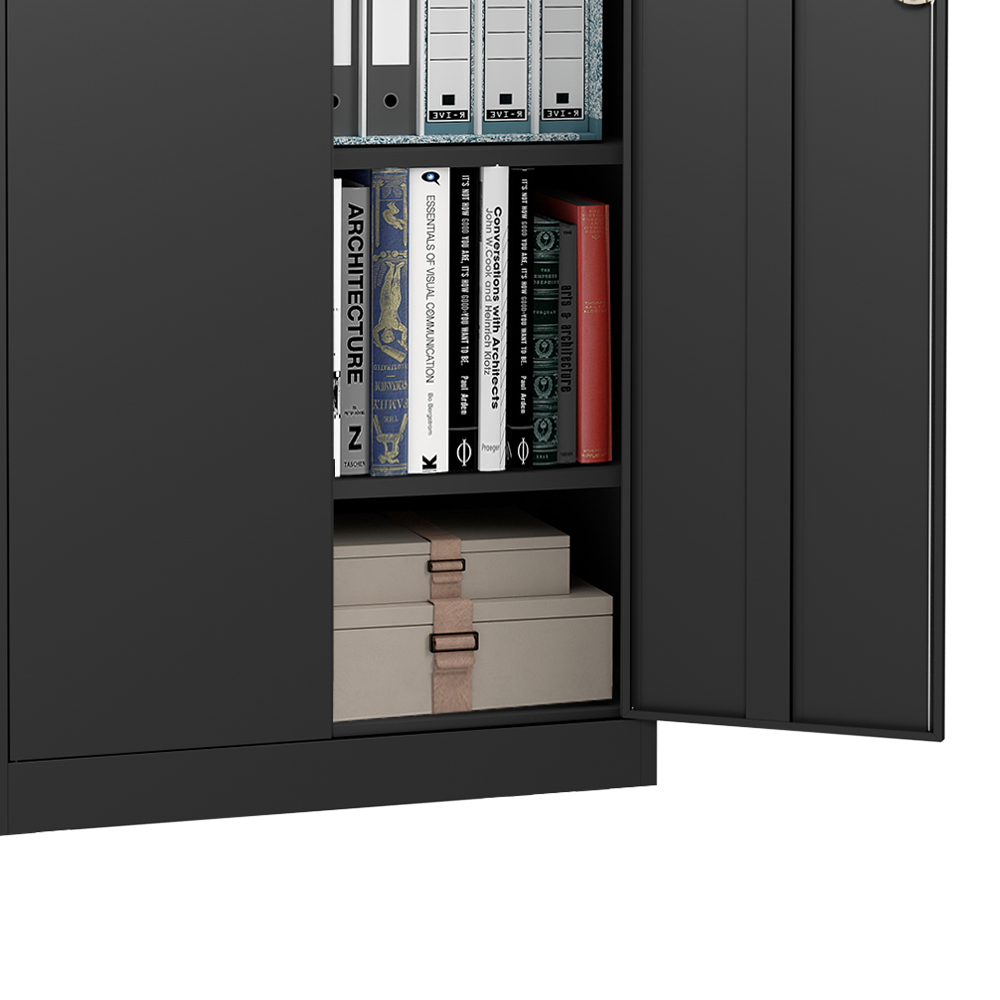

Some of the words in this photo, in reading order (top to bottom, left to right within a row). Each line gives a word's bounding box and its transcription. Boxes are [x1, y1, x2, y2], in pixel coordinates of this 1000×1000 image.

[461, 188, 470, 201] NOT
[425, 194, 436, 251] ESSENTIALS
[485, 208, 494, 234] John
[461, 235, 470, 248] YOU
[493, 206, 503, 302] Conversations
[425, 252, 436, 266] OF
[347, 203, 364, 385] ARCHITECTURE
[425, 267, 436, 301] VISUAL
[484, 280, 493, 302] and
[560, 284, 574, 306] arts
[484, 305, 493, 348] Heinrich
[493, 305, 501, 333] with
[425, 301, 436, 384] COMMUNICATION
[461, 326, 470, 344] WANT
[461, 345, 470, 354] TO
[483, 350, 492, 376] Klotz
[560, 323, 575, 393] architecture
[491, 337, 500, 410] Architects
